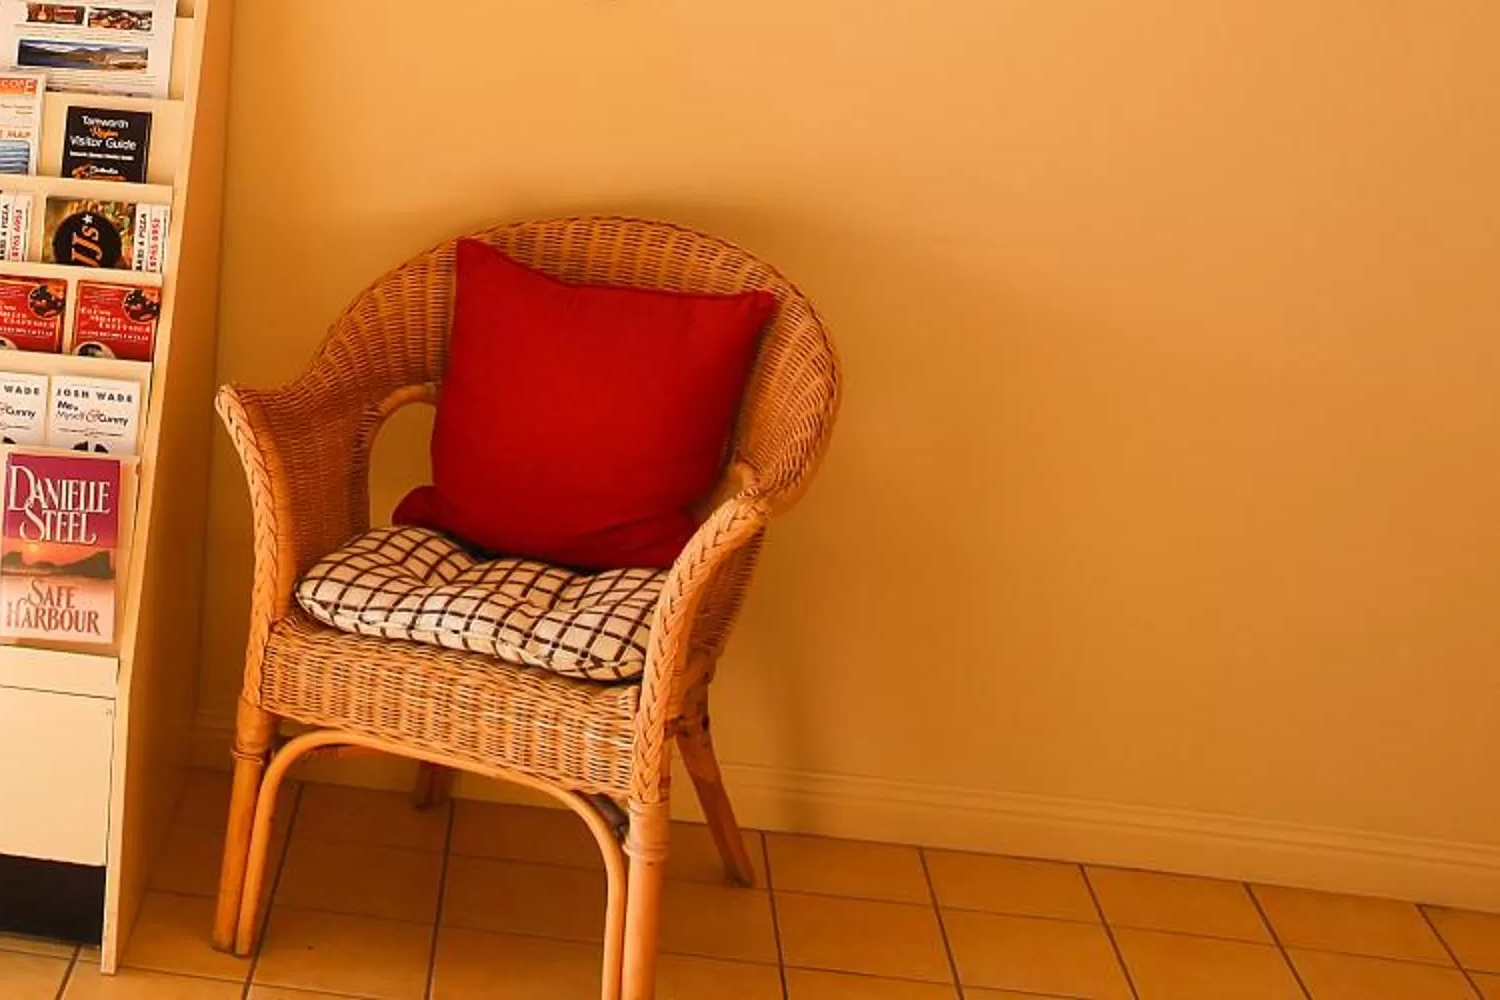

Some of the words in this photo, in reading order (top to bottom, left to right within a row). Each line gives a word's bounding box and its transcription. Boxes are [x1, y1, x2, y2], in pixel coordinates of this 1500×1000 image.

[82, 115, 129, 128] Tamworth
[7, 130, 32, 139] MAP
[69, 135, 103, 147] Visitor
[105, 137, 137, 150] Guide
[0, 204, 10, 229] PIZZA
[138, 213, 147, 239] PIZZA
[4, 384, 40, 396] WADE
[56, 388, 90, 398] JOSH
[97, 392, 133, 403] WADE
[7, 463, 111, 514] DANIELLE
[19, 499, 97, 545] STEEL
[24, 578, 76, 609] SAFE
[5, 601, 100, 635] HARBOUR
